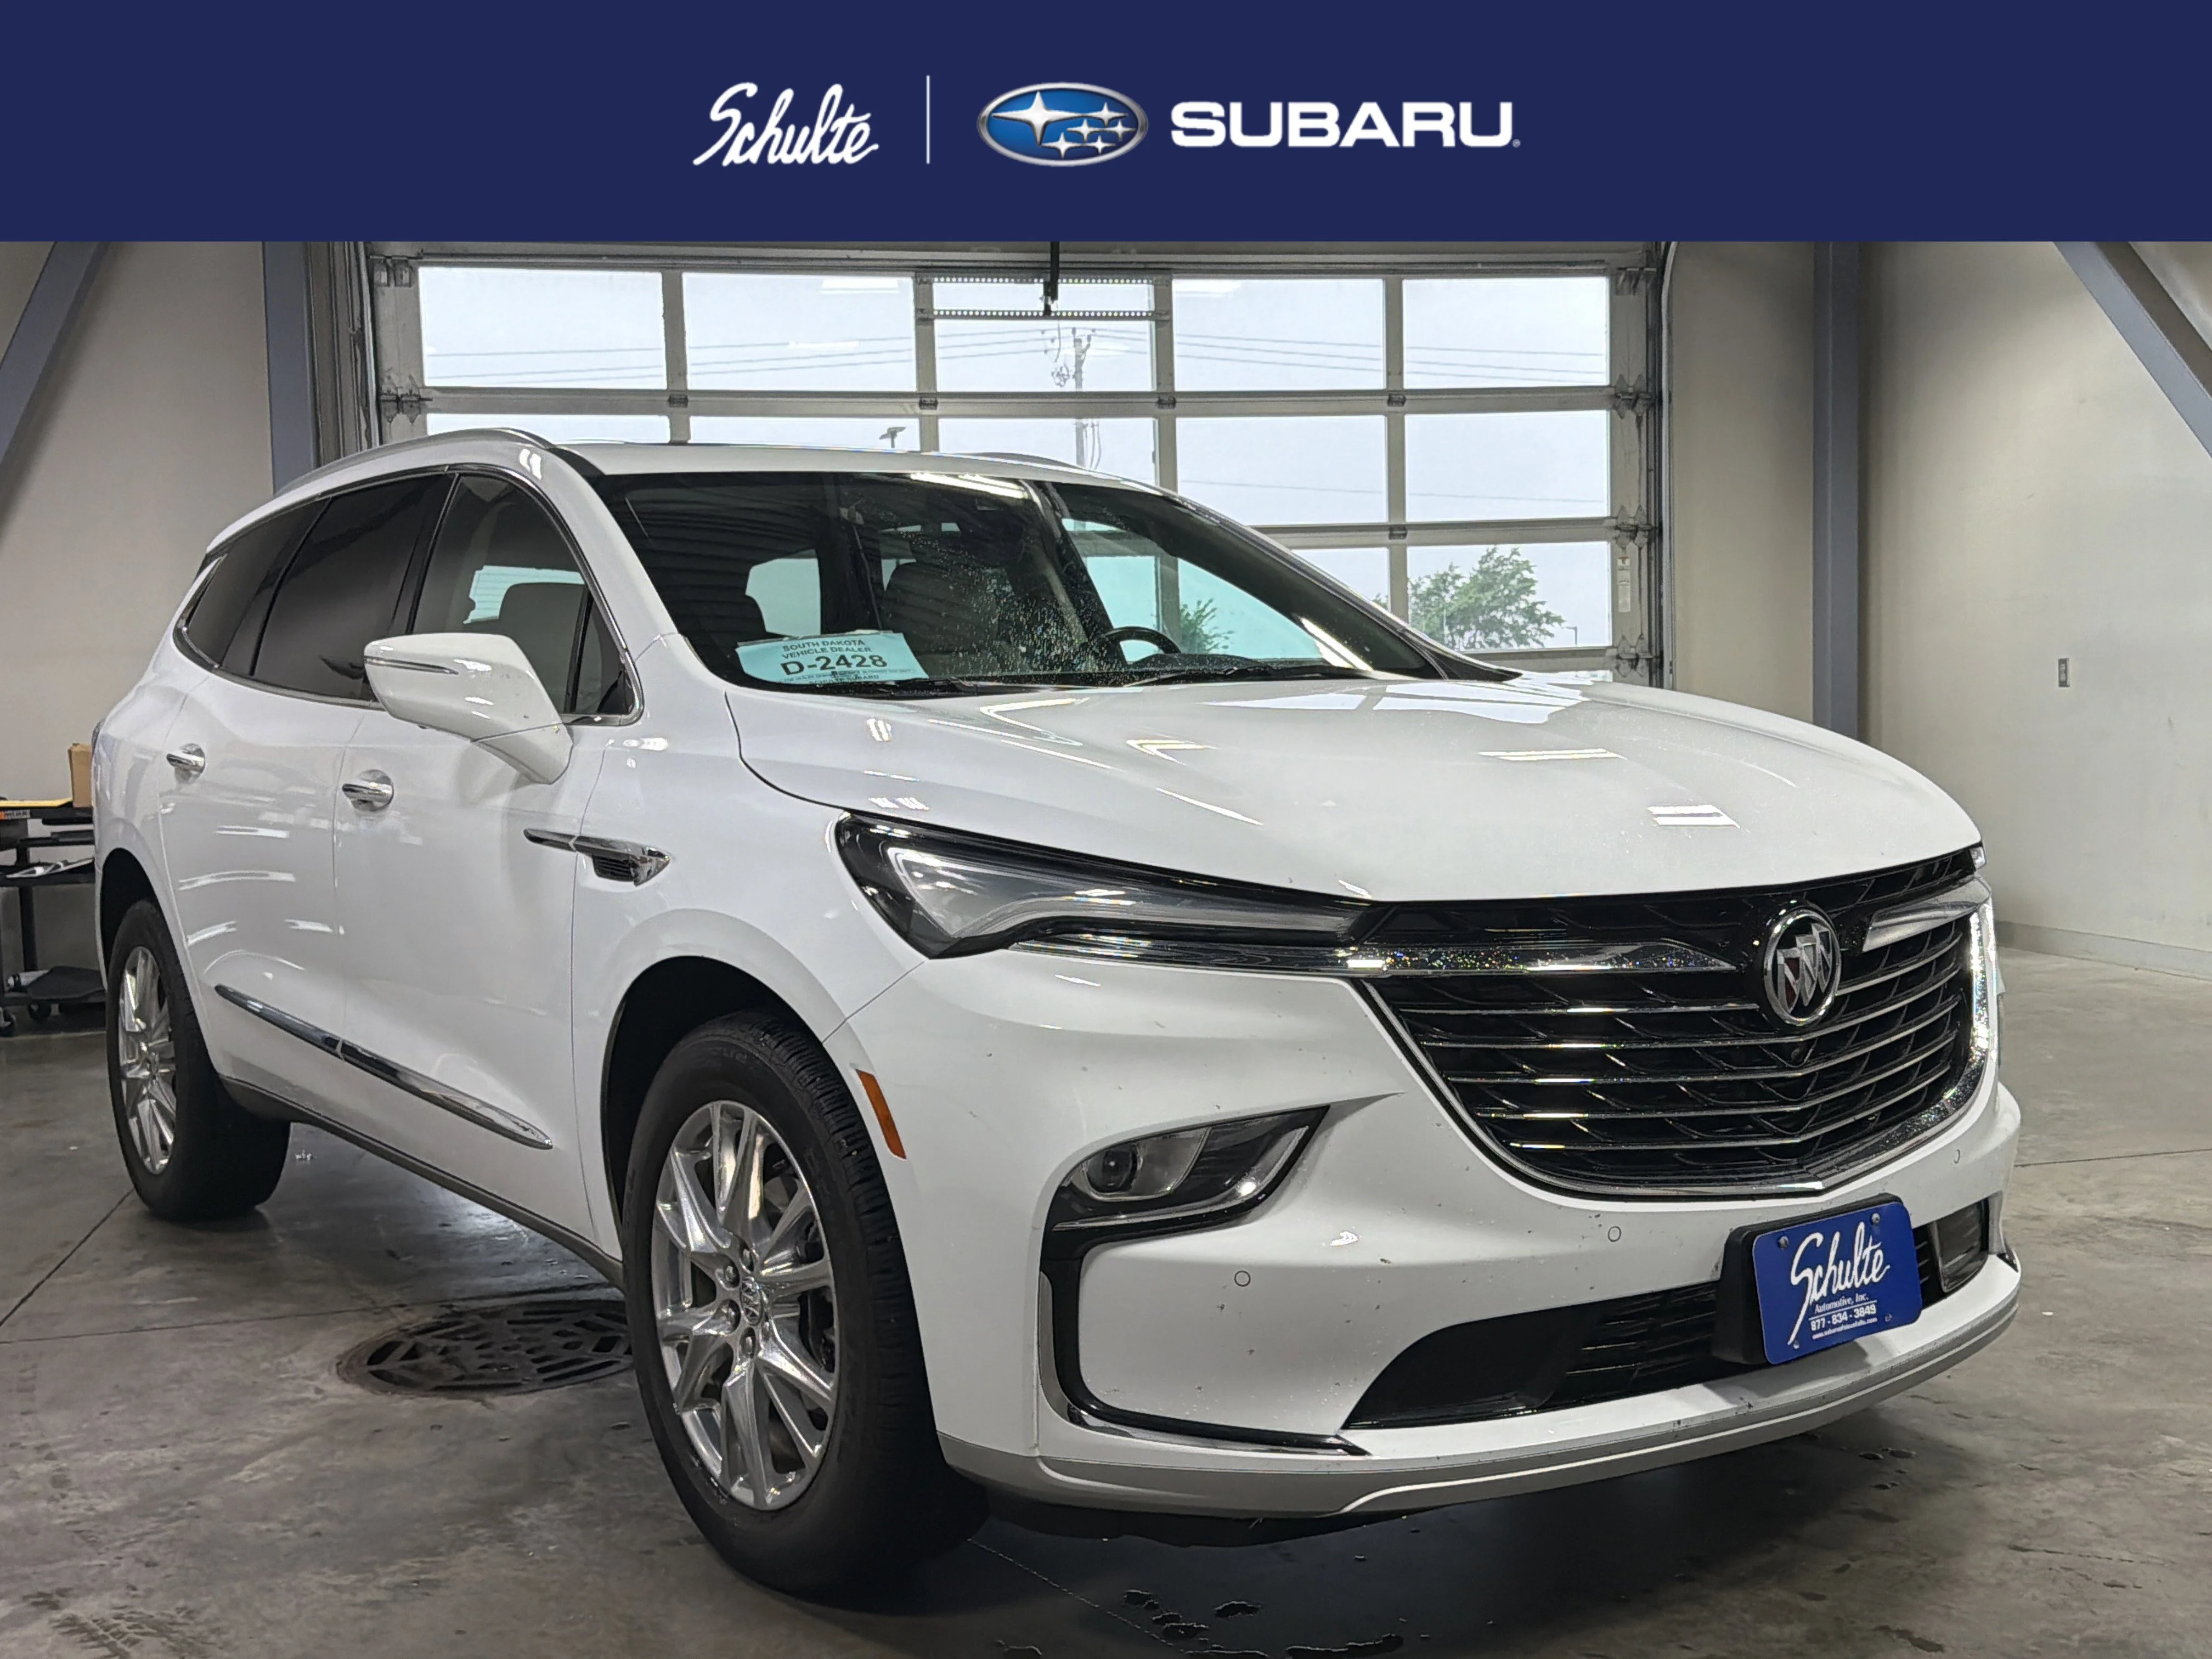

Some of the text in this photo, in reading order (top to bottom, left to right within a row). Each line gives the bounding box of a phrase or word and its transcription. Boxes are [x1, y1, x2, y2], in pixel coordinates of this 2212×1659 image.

[782, 641, 820, 652] SOUTH
[782, 647, 828, 659] VEHICLE
[780, 654, 888, 675] D-2428
[1787, 1221, 1891, 1346] Schulte
[1855, 1293, 1869, 1302] Inc.
